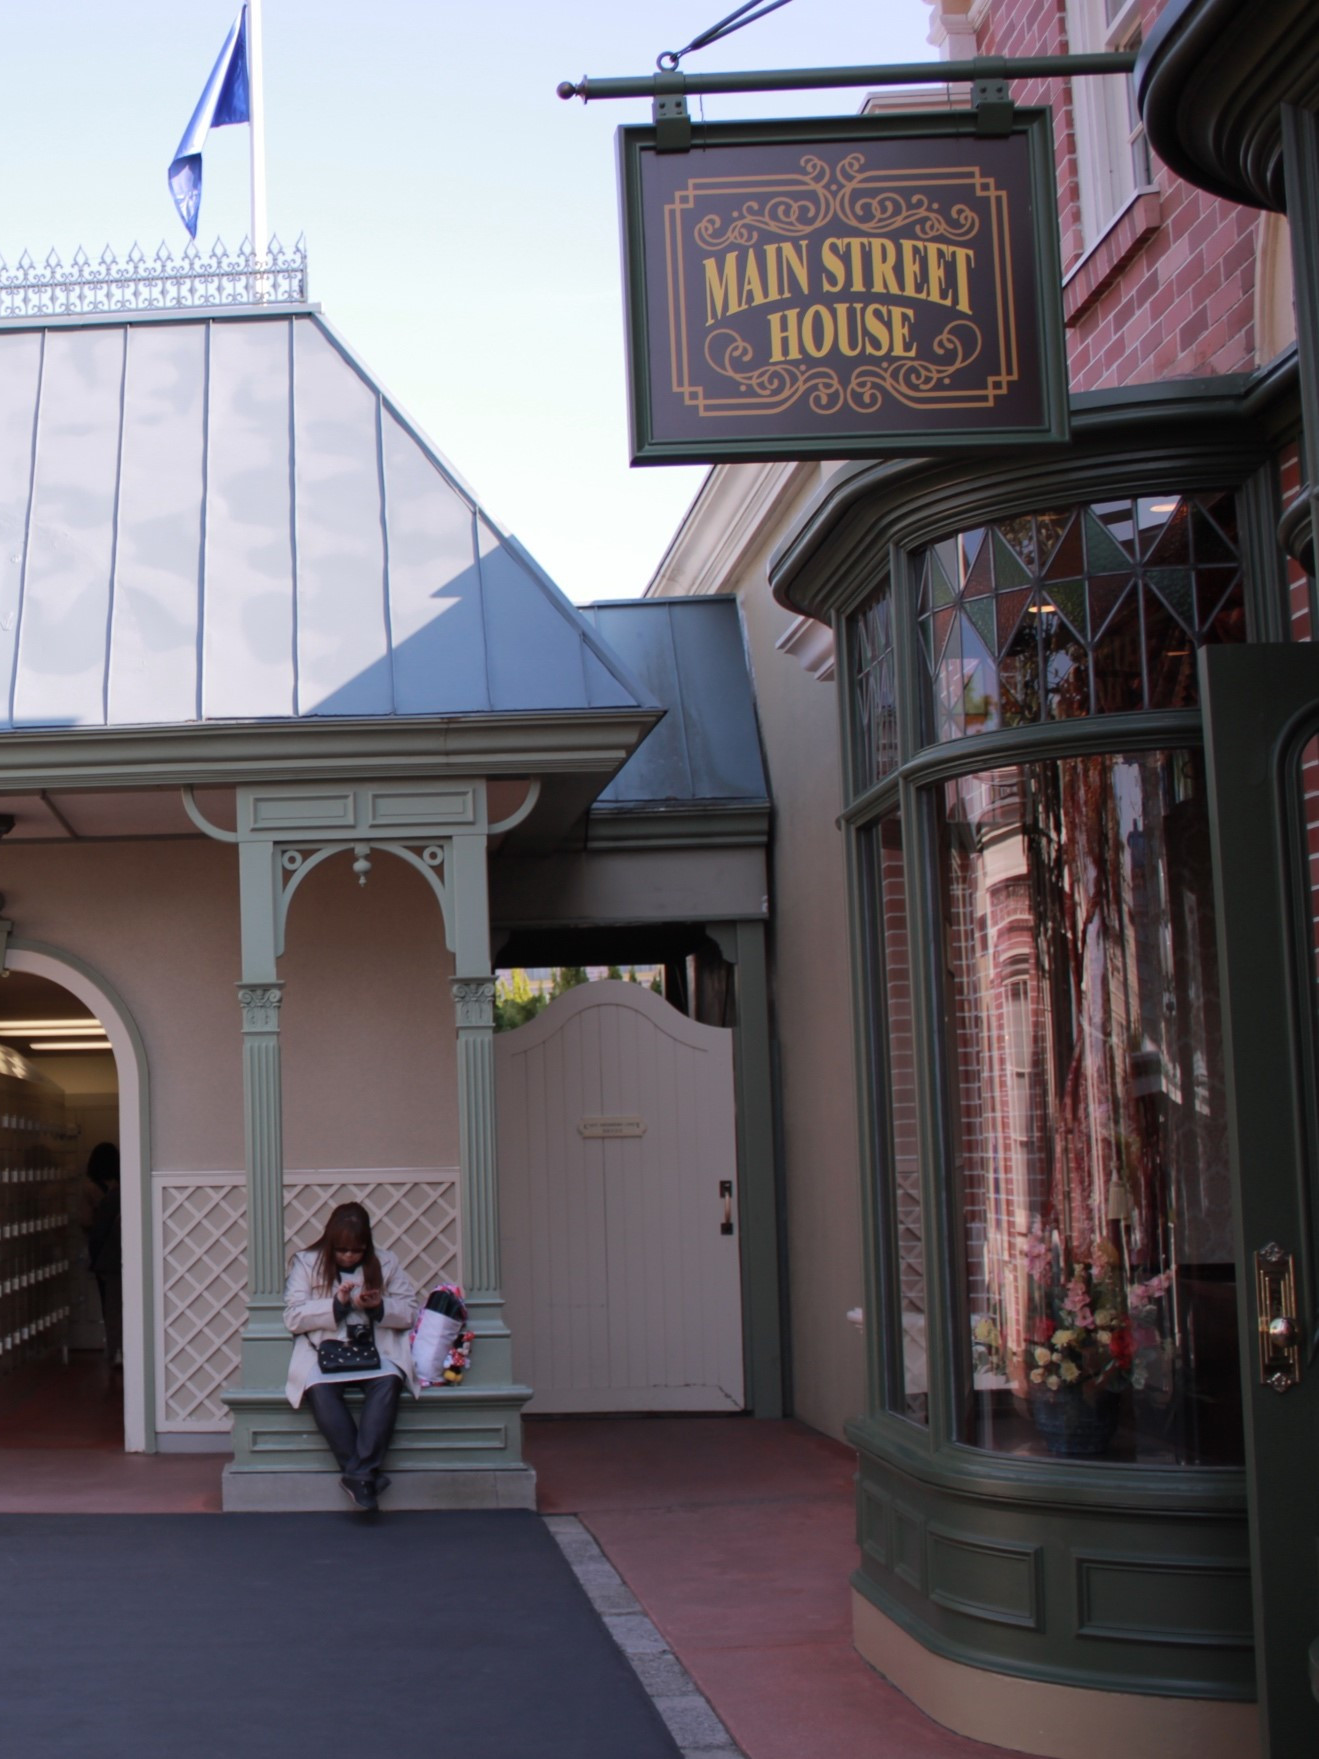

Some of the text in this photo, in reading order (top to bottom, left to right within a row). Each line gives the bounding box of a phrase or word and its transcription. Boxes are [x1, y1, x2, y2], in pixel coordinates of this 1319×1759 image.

[702, 236, 976, 327] MAIN STREET
[767, 302, 918, 363] HOUSE
